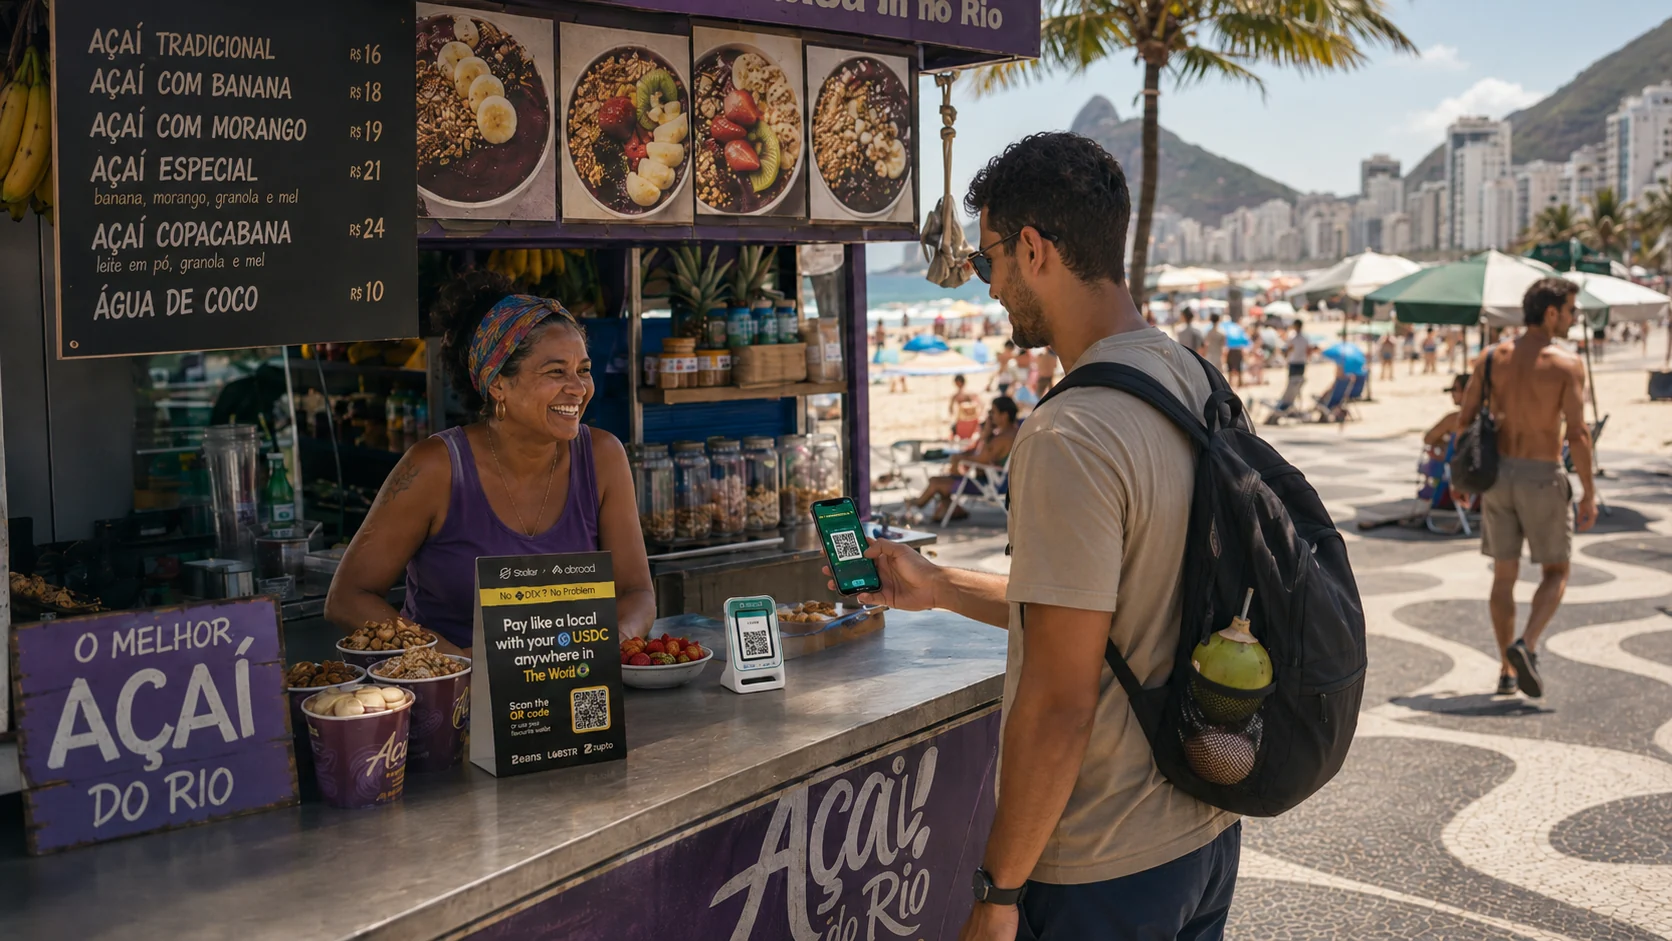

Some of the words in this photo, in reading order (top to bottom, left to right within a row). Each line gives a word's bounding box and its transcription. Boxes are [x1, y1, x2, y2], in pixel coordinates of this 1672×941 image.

[961, 0, 1003, 30] Rio
[88, 22, 143, 60] AÇAÍ
[156, 31, 275, 60] TRADICIONAL
[365, 43, 382, 64] 16
[89, 63, 145, 100] AÇAÍ
[157, 70, 202, 96] COM
[211, 73, 292, 99] BANANA
[365, 81, 382, 102] 18
[90, 106, 145, 144] AÇAÍ
[156, 113, 201, 139] COM
[211, 115, 307, 141] MORANGO
[365, 120, 383, 142] 19
[90, 149, 147, 189] AÇAÍ
[159, 156, 258, 181] ESPECIAL
[363, 159, 381, 181] 21
[94, 187, 147, 207] banana,
[153, 191, 210, 209] morango,
[215, 189, 259, 209] granola
[266, 193, 274, 203] e
[278, 188, 299, 204] mel
[91, 215, 147, 256] AÇAÍ
[156, 220, 292, 247] COPACABANA
[363, 217, 385, 239] 24
[96, 255, 122, 273] leite
[129, 259, 147, 272] em
[153, 254, 173, 276] pó,
[180, 252, 224, 274] granola
[232, 257, 240, 267] e
[245, 252, 265, 267] mel
[93, 284, 155, 321] ÁGUA
[166, 288, 194, 316] DE
[204, 285, 258, 314] COCO
[366, 280, 384, 302] 10
[500, 592, 512, 600] No
[550, 588, 561, 597] No
[563, 586, 595, 596] Problem
[503, 618, 527, 634] Pay
[530, 615, 552, 629] like
[555, 618, 564, 627] a
[566, 611, 597, 627] local
[74, 632, 98, 663] O
[112, 617, 232, 659] MELHOR
[495, 635, 524, 650] with
[527, 636, 555, 651] your
[572, 628, 609, 643] USDC
[514, 650, 580, 668] anywhere
[582, 647, 594, 659] in
[523, 669, 546, 682] The
[47, 636, 255, 771] AÇAÍ
[509, 701, 532, 710] Scan
[534, 698, 549, 709] the
[527, 708, 549, 718] code
[88, 781, 149, 828] DO
[164, 767, 234, 814] RIO
[862, 862, 930, 941] Rio
